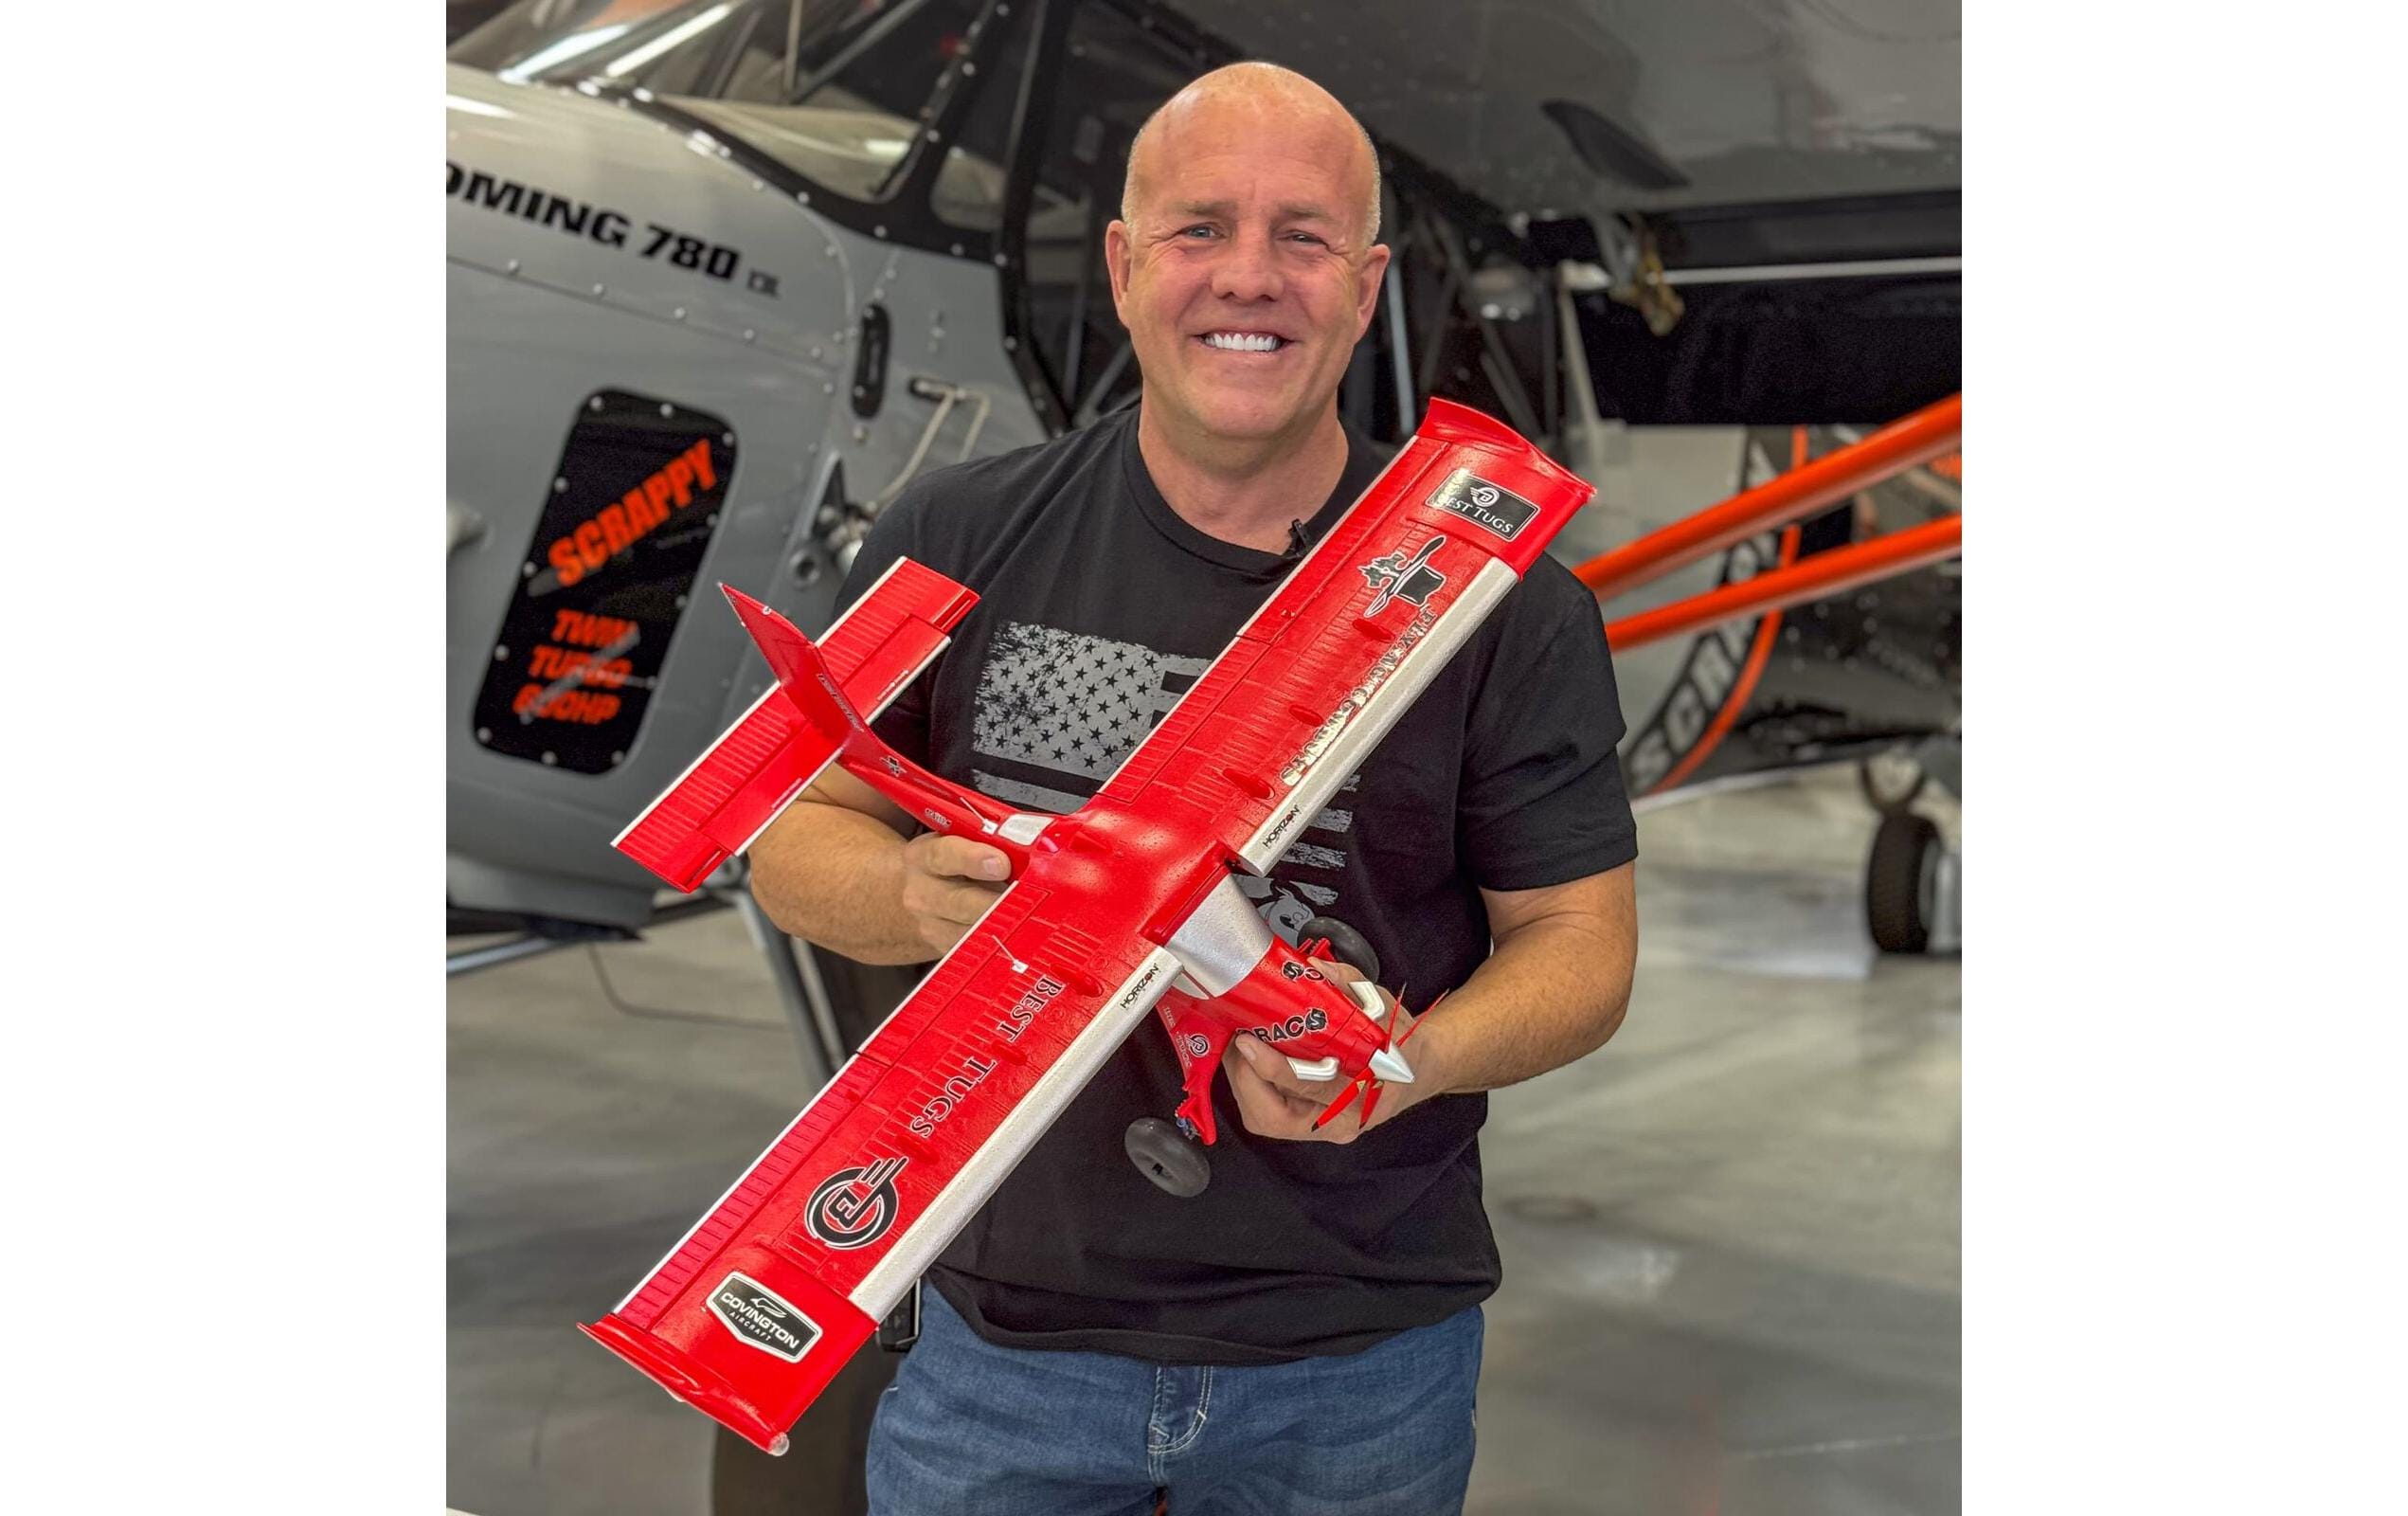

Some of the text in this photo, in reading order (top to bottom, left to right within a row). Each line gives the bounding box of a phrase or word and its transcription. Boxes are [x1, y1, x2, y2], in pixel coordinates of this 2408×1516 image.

[638, 221, 741, 284] 780
[548, 437, 717, 587] SCRAPPY
[1436, 493, 1514, 533] EST TUGS
[1263, 804, 1301, 848] HORIZON
[1120, 963, 1159, 1009] HORIZON
[909, 974, 1068, 1139] BEST TUGS
[720, 1291, 800, 1349] COVINGTON
[728, 1311, 772, 1342] AIRCRAFT
